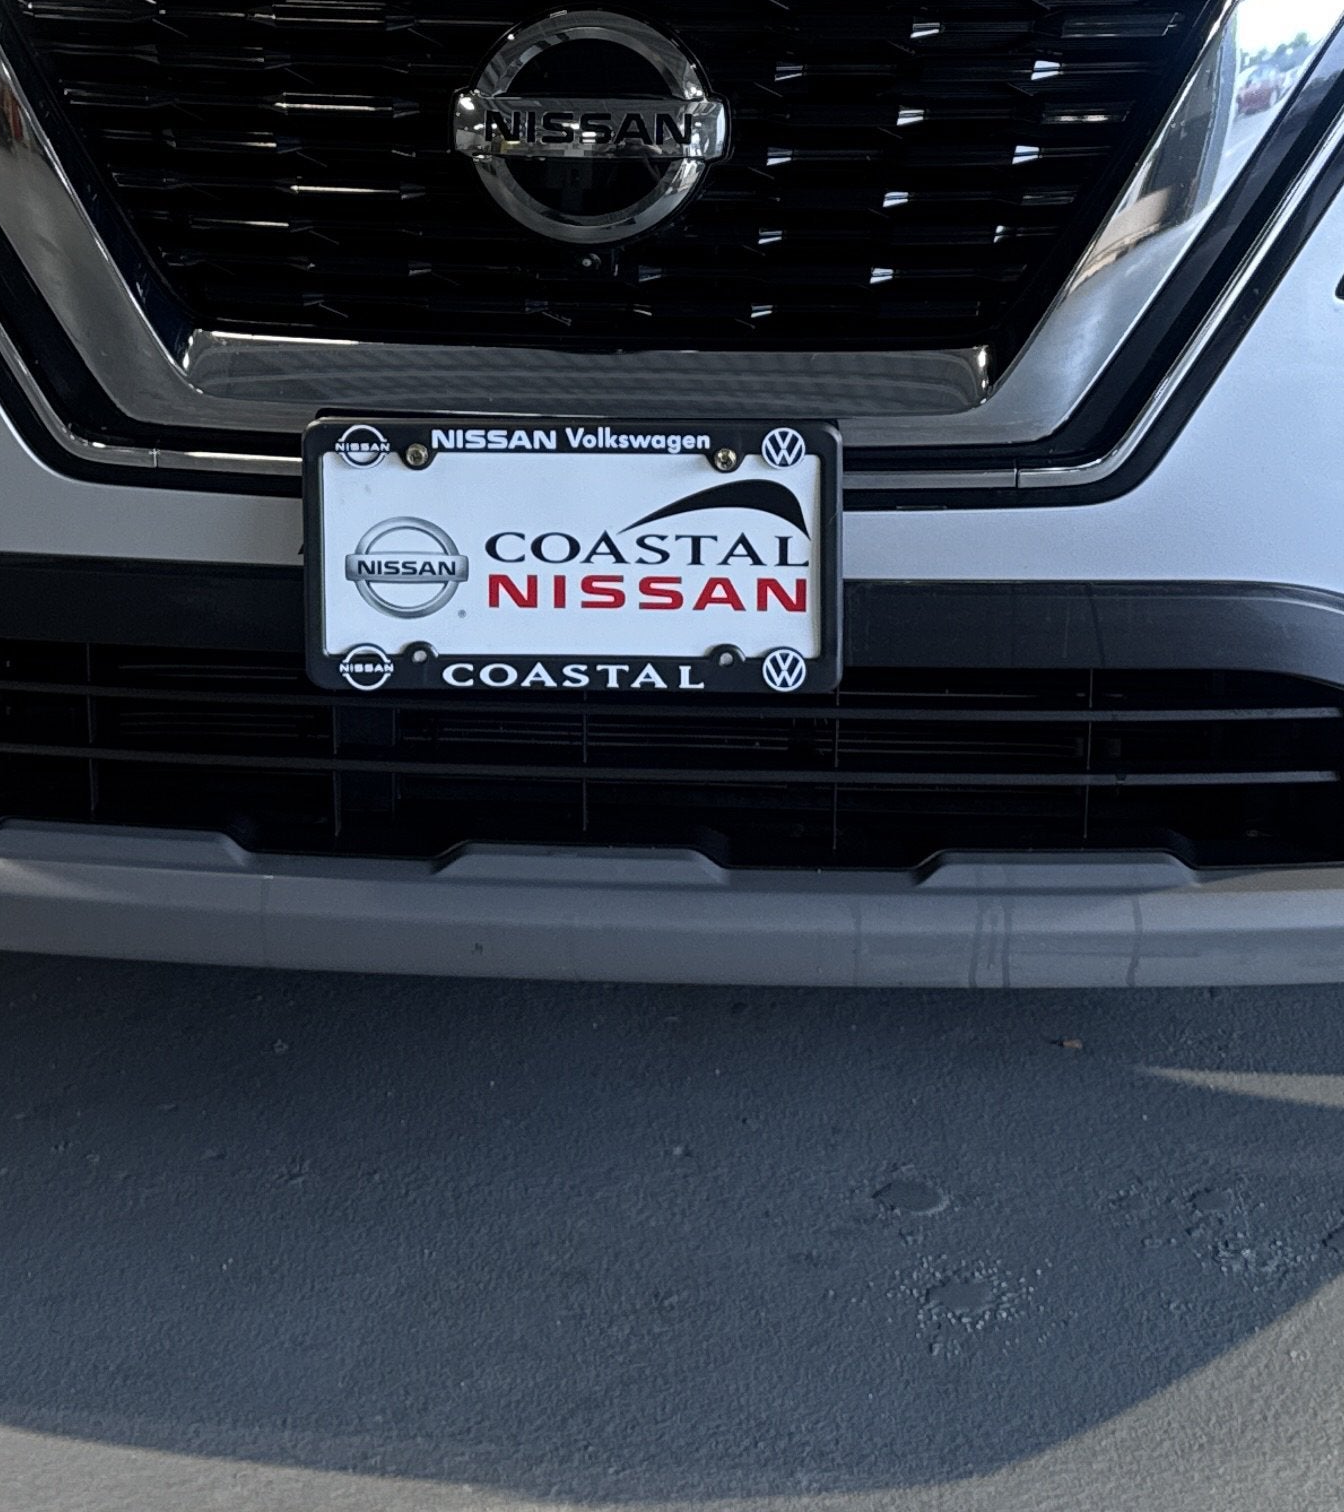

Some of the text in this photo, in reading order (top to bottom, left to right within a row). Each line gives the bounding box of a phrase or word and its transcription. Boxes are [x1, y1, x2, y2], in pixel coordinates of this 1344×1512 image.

[484, 110, 692, 145] NISSAN
[335, 441, 390, 452] NISSAN
[432, 427, 710, 454] NISSAN Volkswagen
[484, 530, 810, 567] COASTAL
[357, 560, 456, 576] NISSAN
[488, 574, 807, 613] NISSAN
[339, 662, 394, 673] NISSAN
[442, 662, 705, 689] COASTAL
